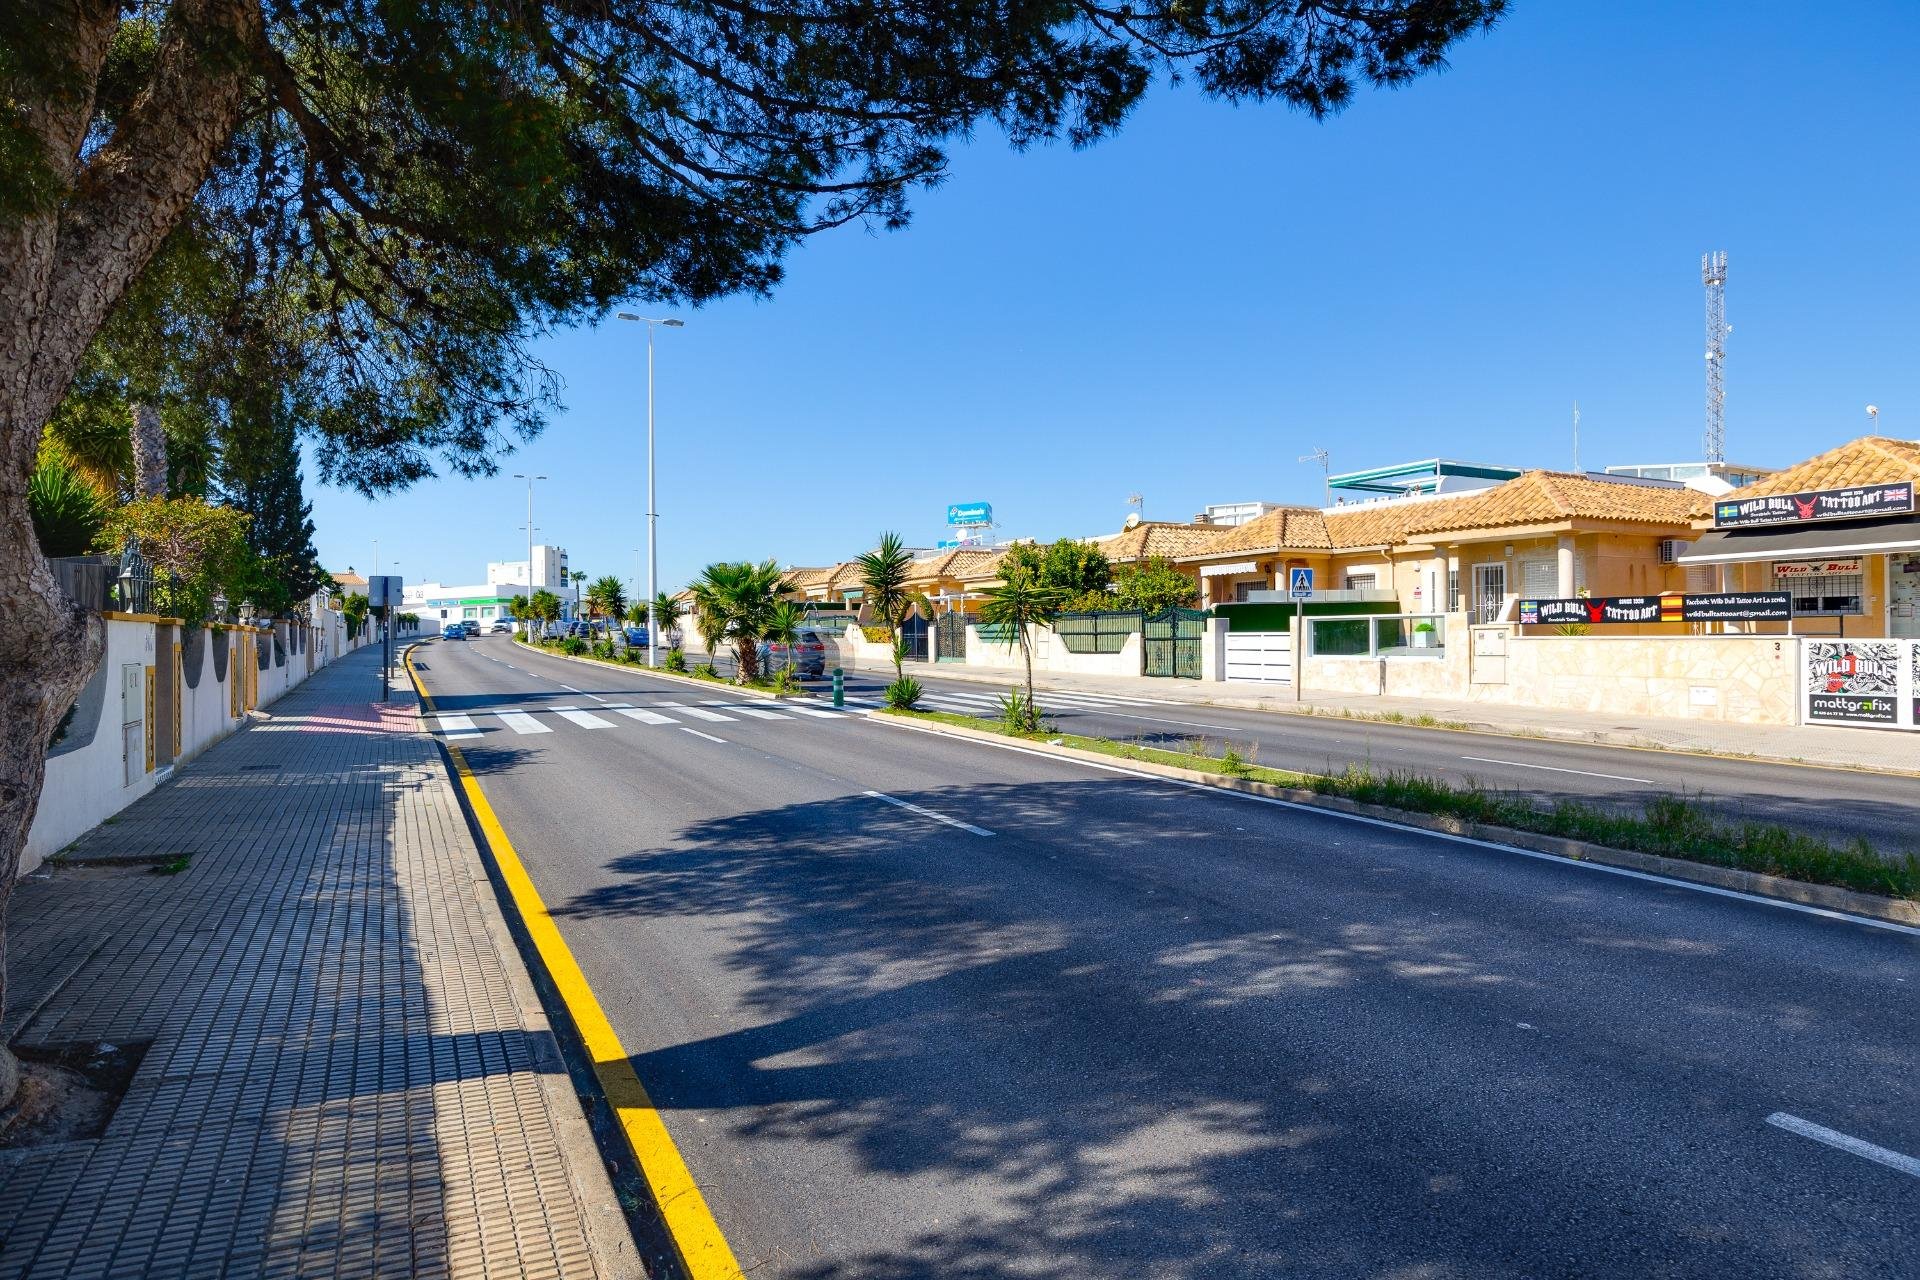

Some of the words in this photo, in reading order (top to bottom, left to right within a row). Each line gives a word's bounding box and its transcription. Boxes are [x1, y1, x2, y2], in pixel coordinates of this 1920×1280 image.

[1740, 499, 1765, 515] WILD
[1768, 498, 1794, 511] BULL
[1820, 496, 1860, 508] TATTOO
[1862, 490, 1882, 506] ART
[1540, 602, 1562, 616] WILD
[1565, 601, 1587, 616] BULL
[1606, 606, 1639, 620] TATTOO
[1641, 605, 1658, 619] ART
[1686, 609, 1787, 618] wildbulltattooart@gmail.com
[1775, 642, 1780, 650] 3
[1815, 659, 1850, 676] WILD
[1856, 659, 1890, 677] BULL
[1815, 699, 1891, 711] mattgrafix
